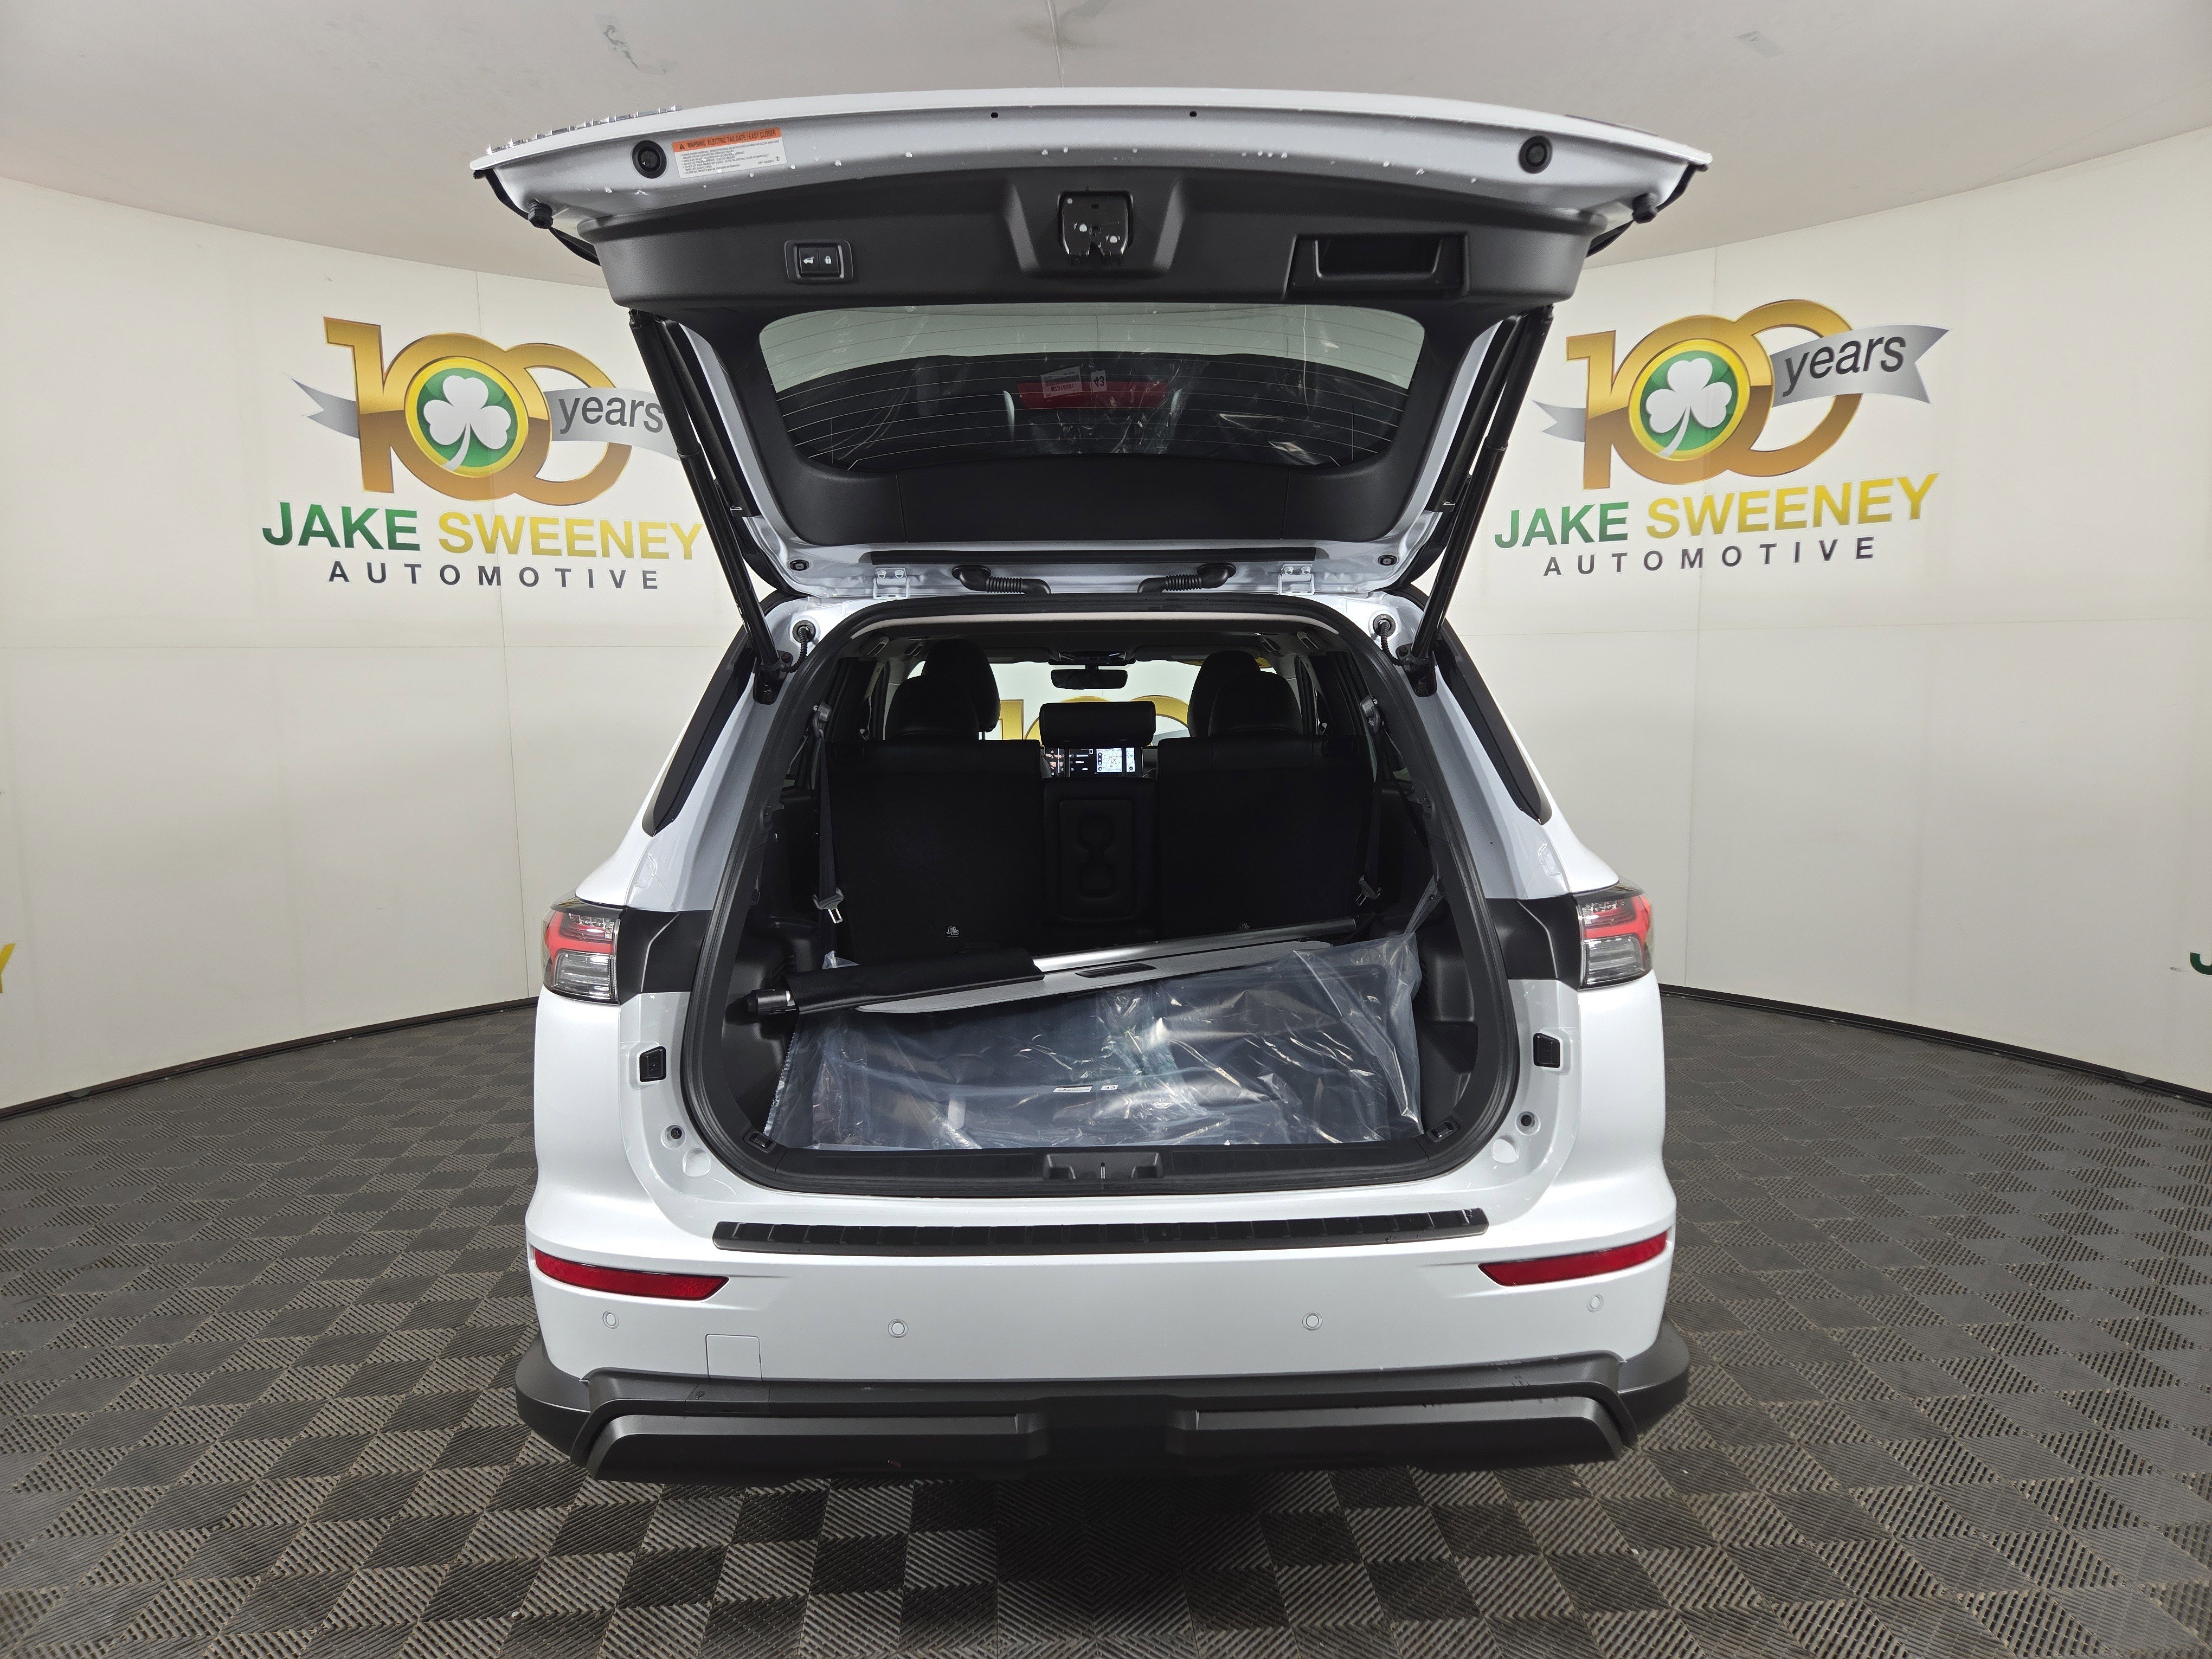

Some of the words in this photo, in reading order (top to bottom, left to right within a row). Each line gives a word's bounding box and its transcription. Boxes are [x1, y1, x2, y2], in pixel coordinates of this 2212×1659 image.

[559, 396, 664, 434] years
[1566, 299, 1864, 490] 100
[1782, 335, 1906, 397] years
[262, 501, 421, 551] JAKE
[439, 512, 703, 561] SWEENEY
[1495, 501, 1629, 549] JAKE
[1647, 473, 1940, 539] SWEENEY
[329, 561, 659, 590] AUTOMOTIVE
[1543, 537, 1874, 576] AUTOMOTIVE
